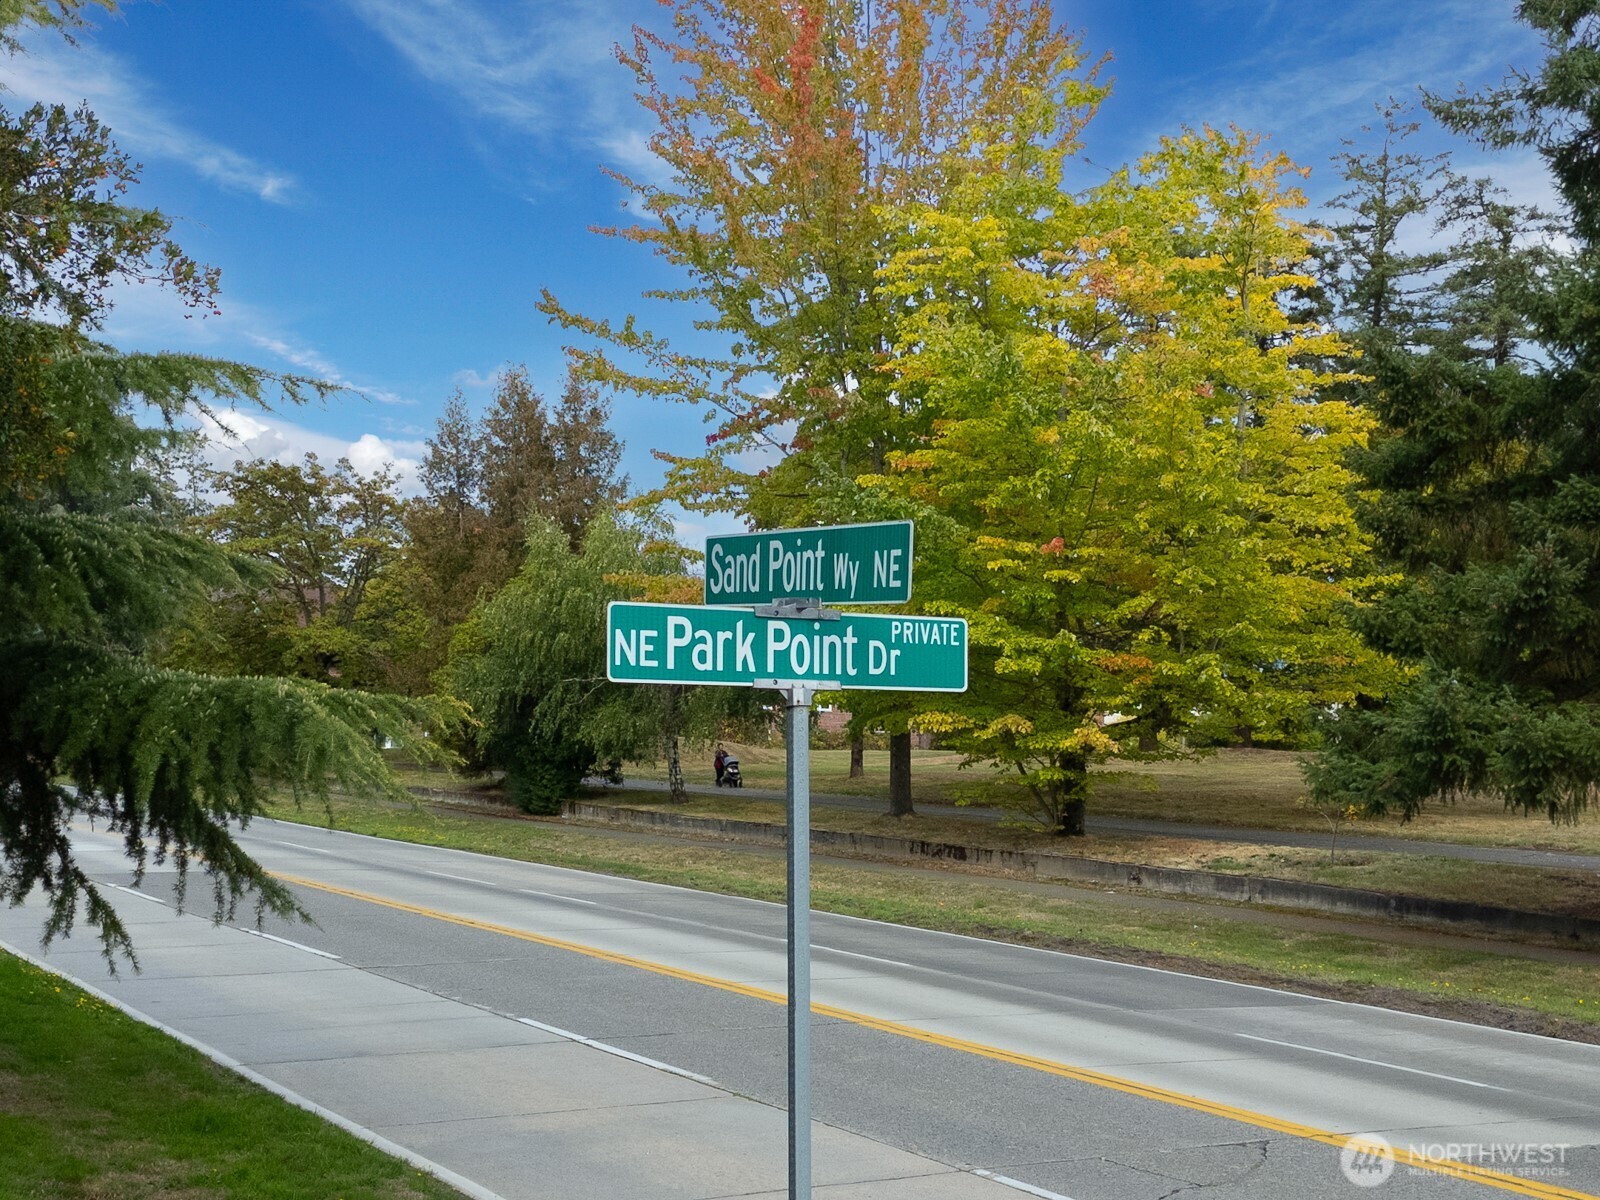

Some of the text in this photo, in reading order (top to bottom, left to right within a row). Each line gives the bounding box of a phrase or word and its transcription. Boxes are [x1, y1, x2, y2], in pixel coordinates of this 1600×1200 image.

[710, 537, 902, 598] Sand Point Wy NE
[614, 615, 901, 676] NE Park Point Dr
[891, 621, 960, 646] PRIVATE
